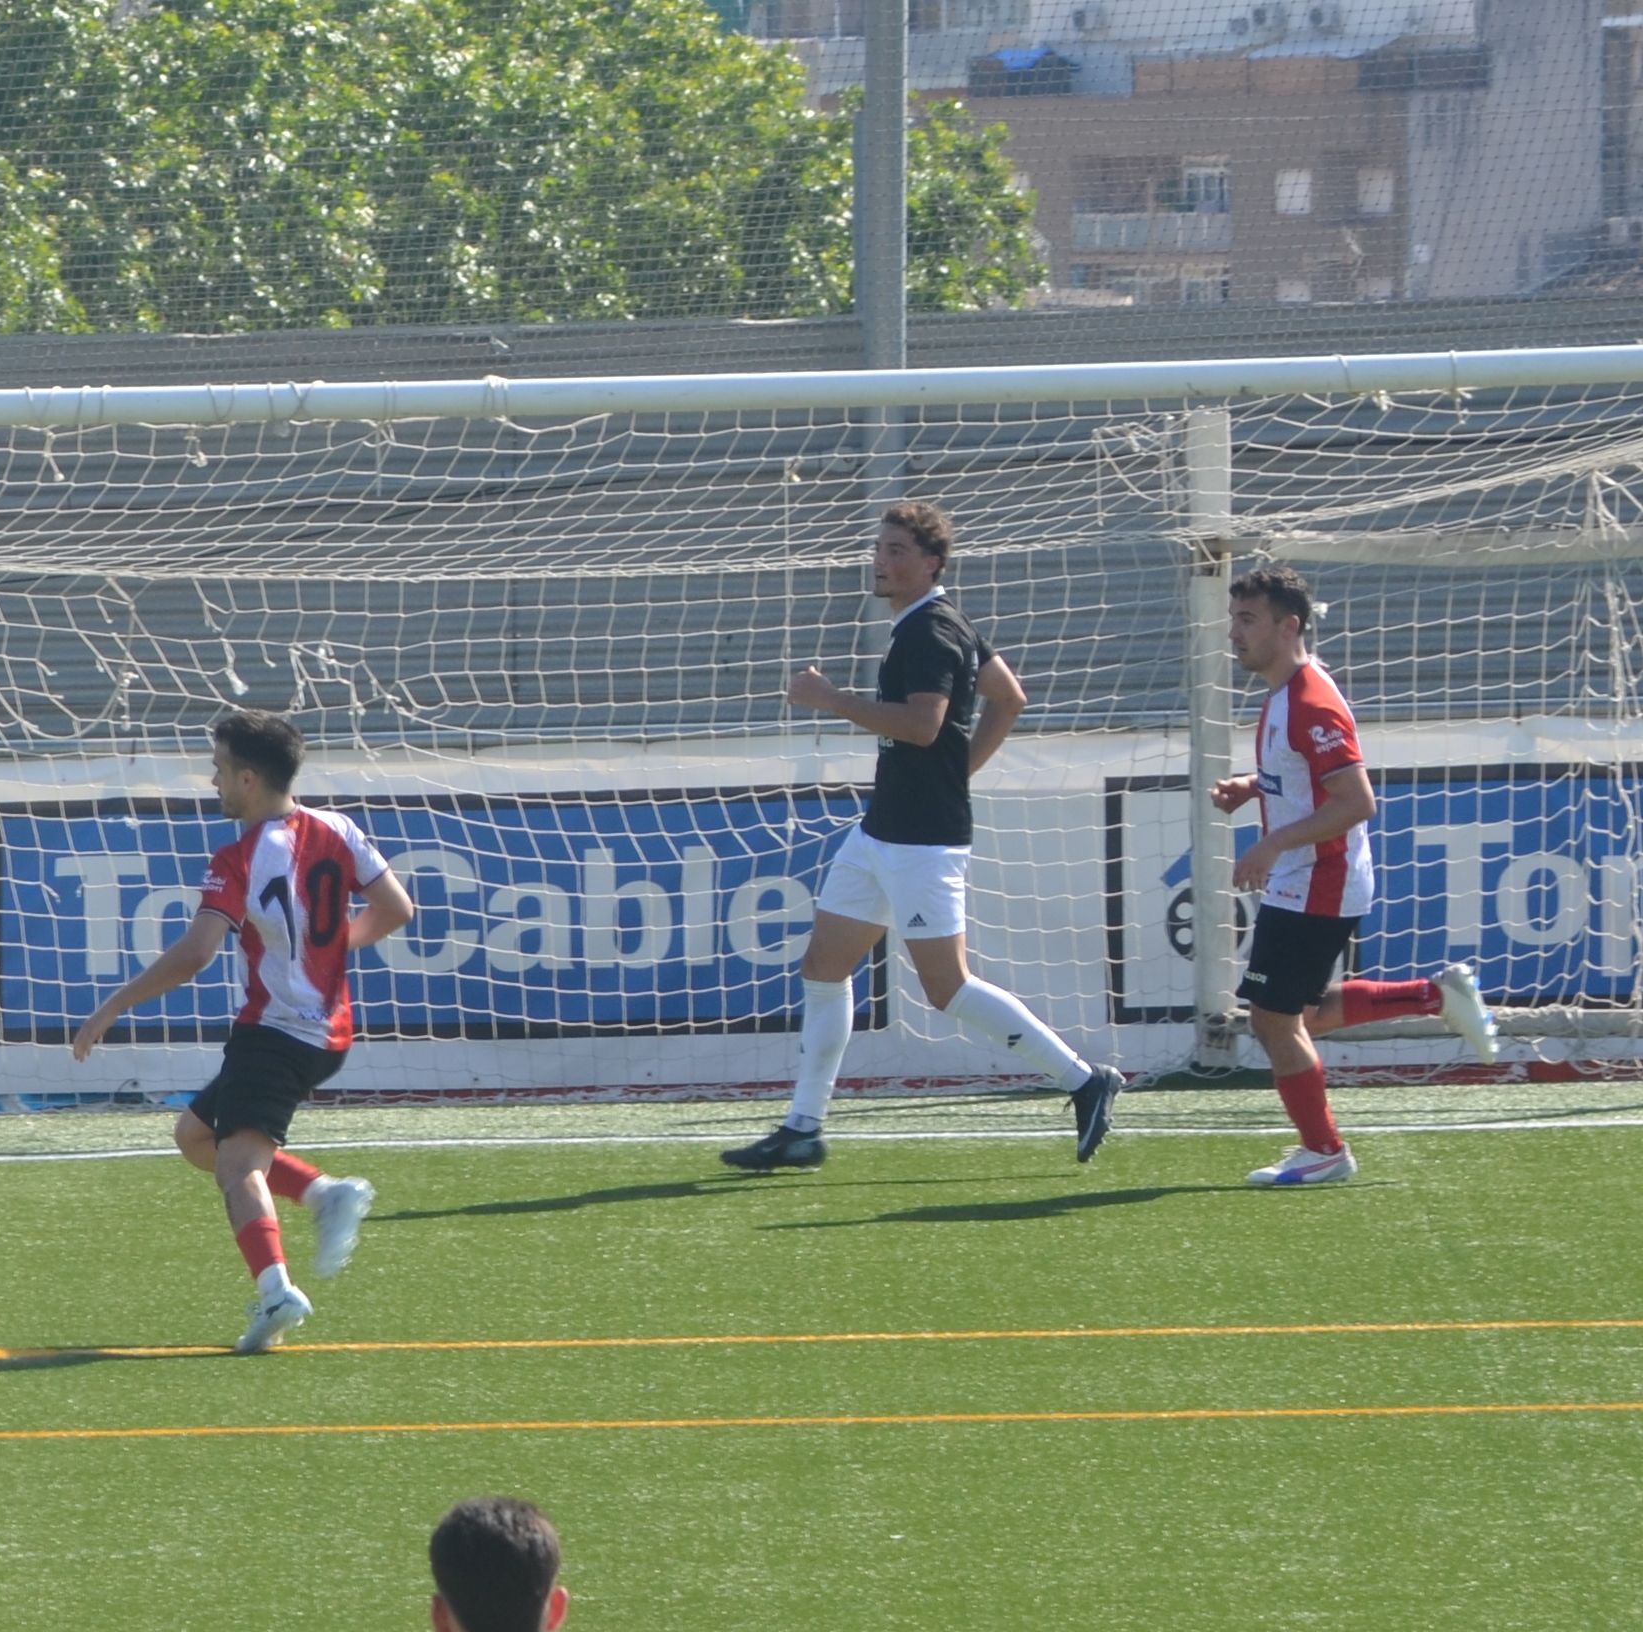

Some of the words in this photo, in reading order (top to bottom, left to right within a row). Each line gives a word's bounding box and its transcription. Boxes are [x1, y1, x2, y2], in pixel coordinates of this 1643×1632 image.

[55, 854, 237, 990] To
[372, 846, 815, 973] Cable
[258, 858, 342, 961] 10
